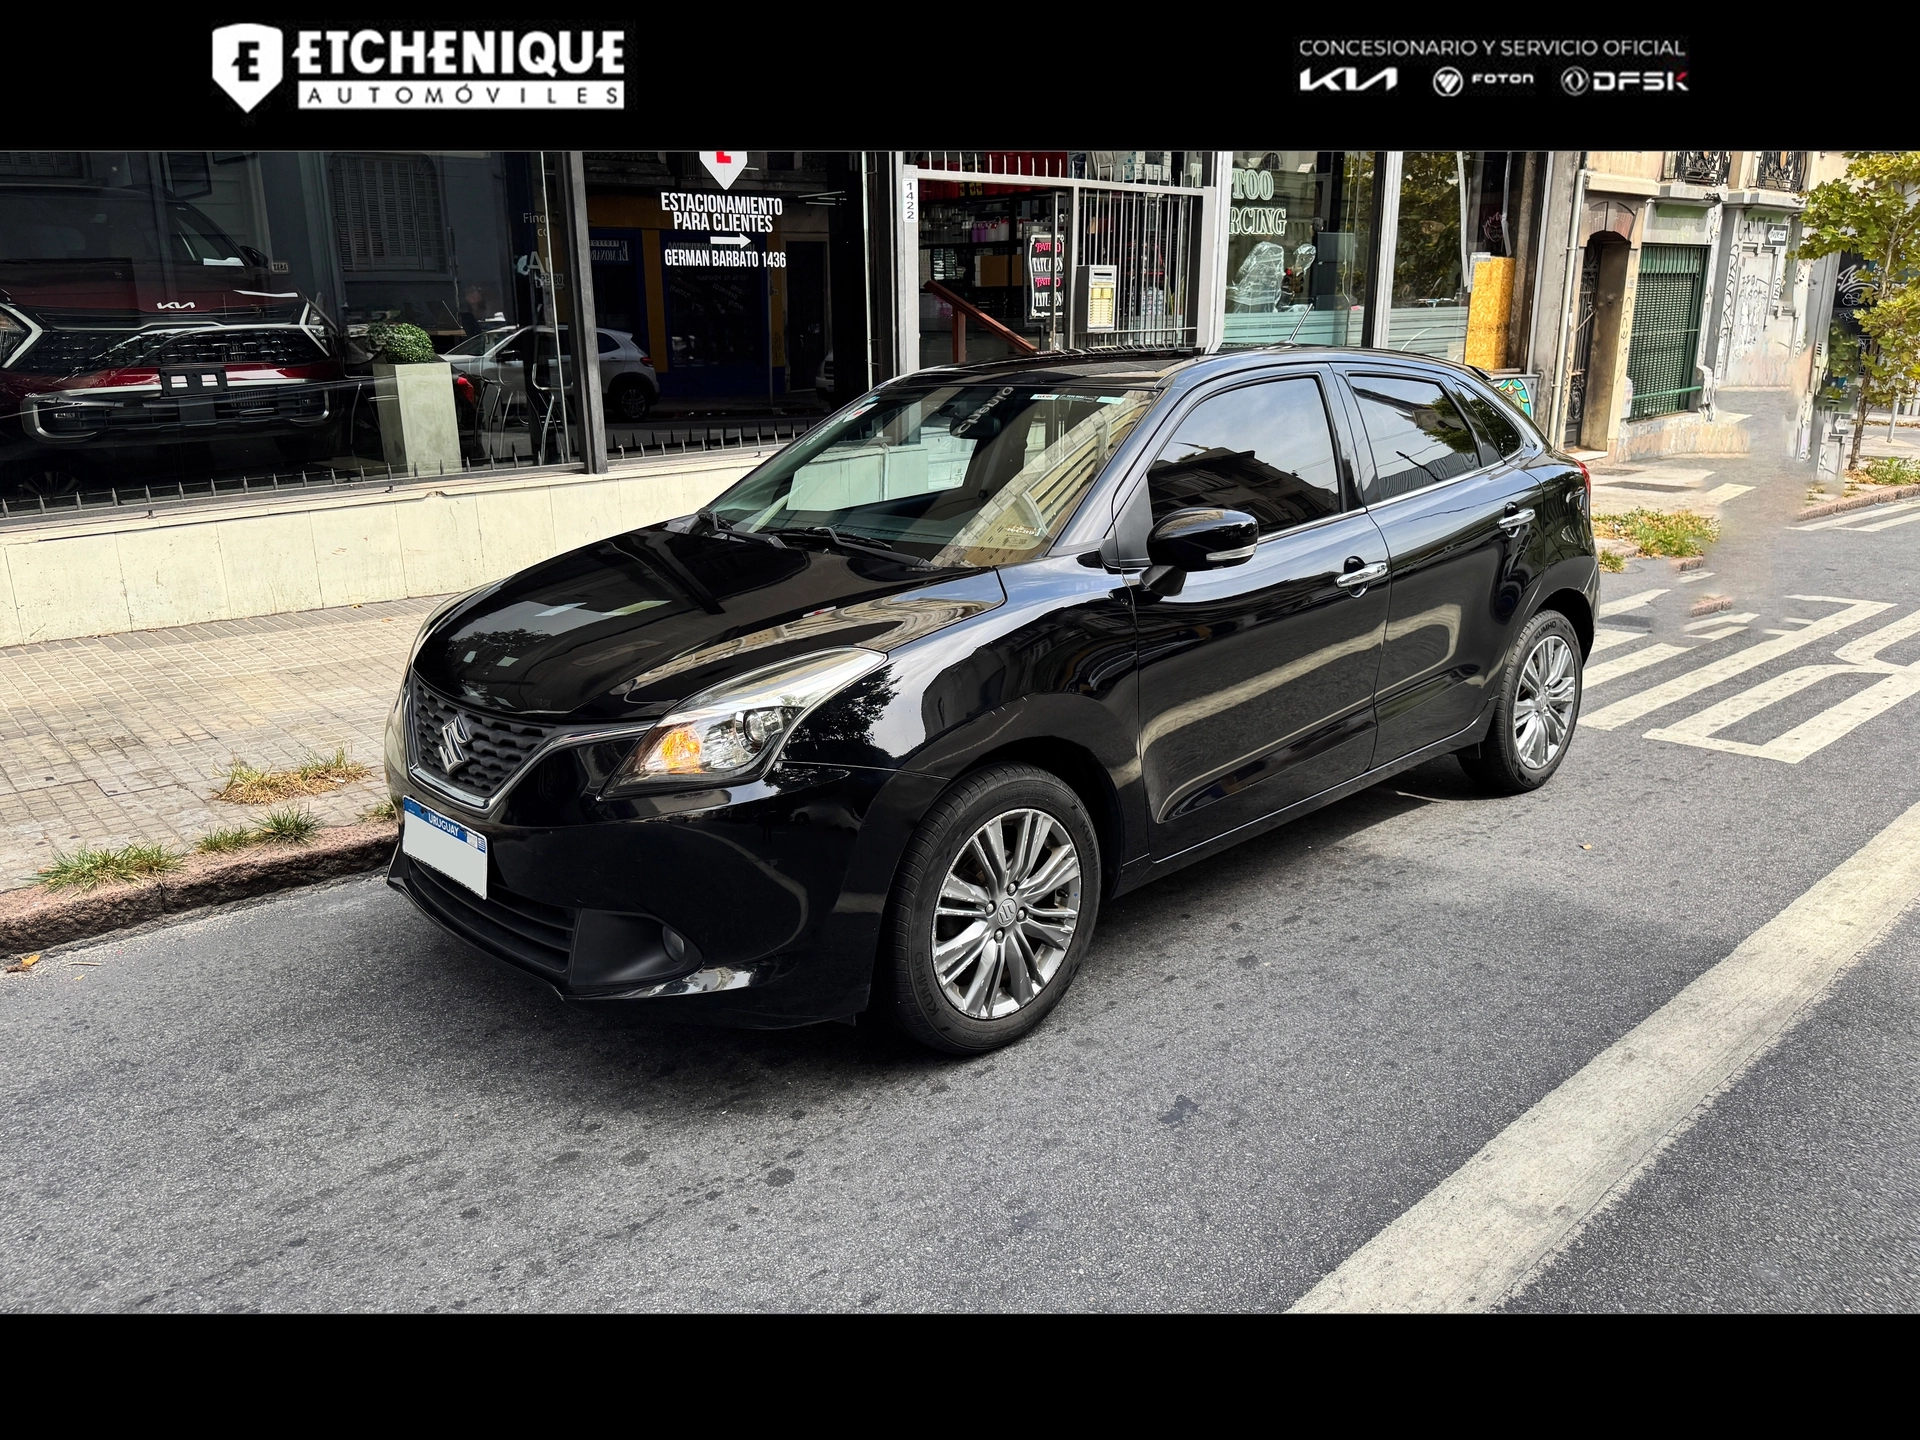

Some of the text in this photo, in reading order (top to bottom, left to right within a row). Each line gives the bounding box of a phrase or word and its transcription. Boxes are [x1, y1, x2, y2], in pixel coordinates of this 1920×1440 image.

[661, 192, 783, 216] ESTACIONAMIENTO
[906, 182, 915, 220] 1422
[673, 211, 774, 233] PARA CLIENTES
[664, 249, 787, 268] GERMAN BARBATO 1436
[428, 812, 460, 837] URUGUAY
[914, 951, 940, 1017] KUMHO
